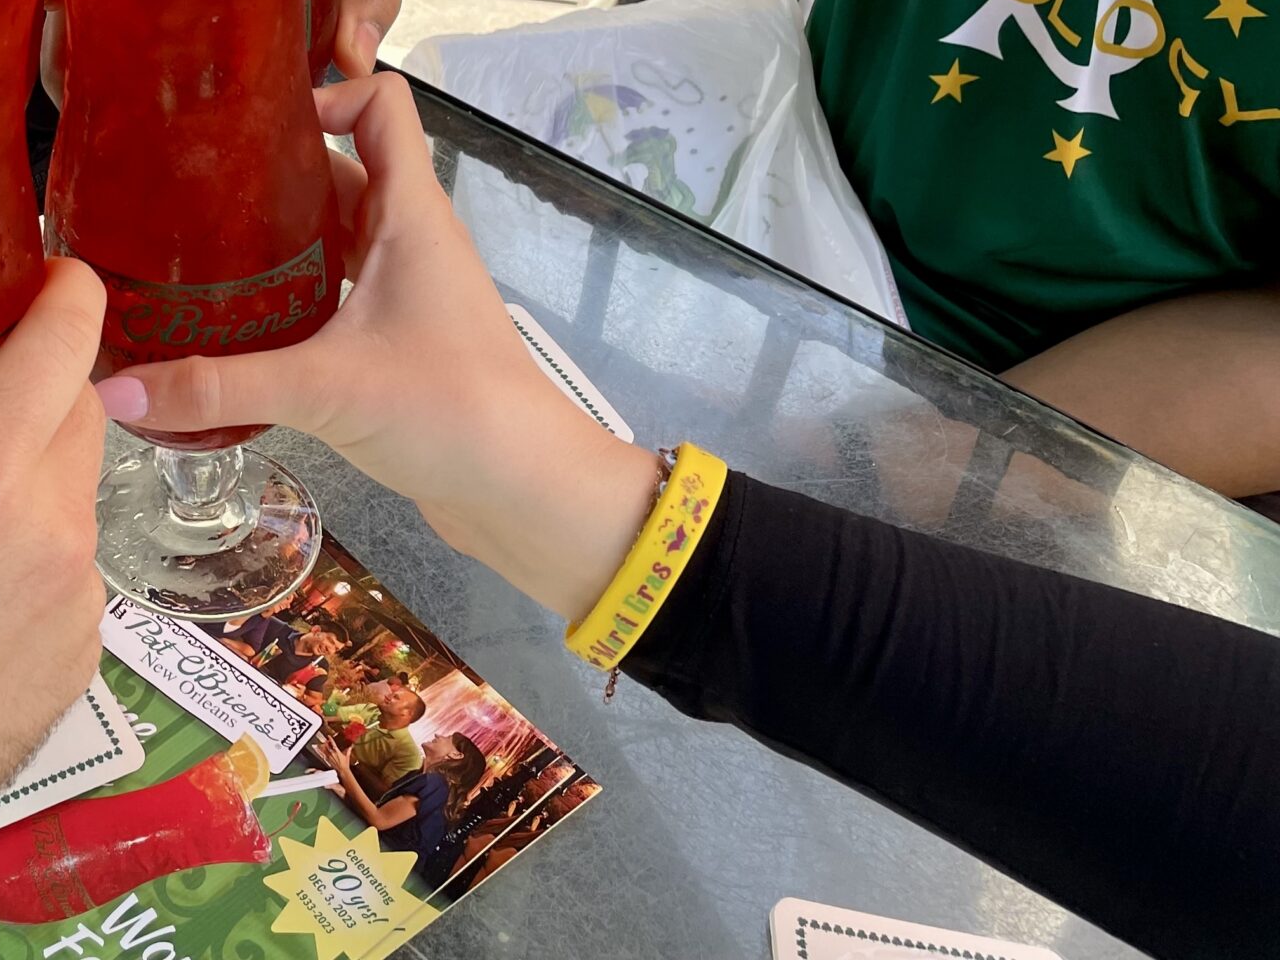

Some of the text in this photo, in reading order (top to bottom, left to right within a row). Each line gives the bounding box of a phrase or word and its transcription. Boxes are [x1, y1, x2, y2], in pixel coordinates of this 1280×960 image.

[122, 293, 315, 346] O'Brien's
[590, 561, 672, 661] Mardi Gras
[124, 612, 176, 656] Pat
[176, 652, 280, 742] O'Brien's
[140, 651, 177, 682] New
[179, 680, 237, 728] Orleans
[308, 873, 357, 929] DEC. 3, 2023
[318, 858, 389, 924] 90 yrs!
[345, 849, 396, 906] Celebrating
[101, 892, 192, 960] Wo
[296, 889, 336, 935] 1933-2023
